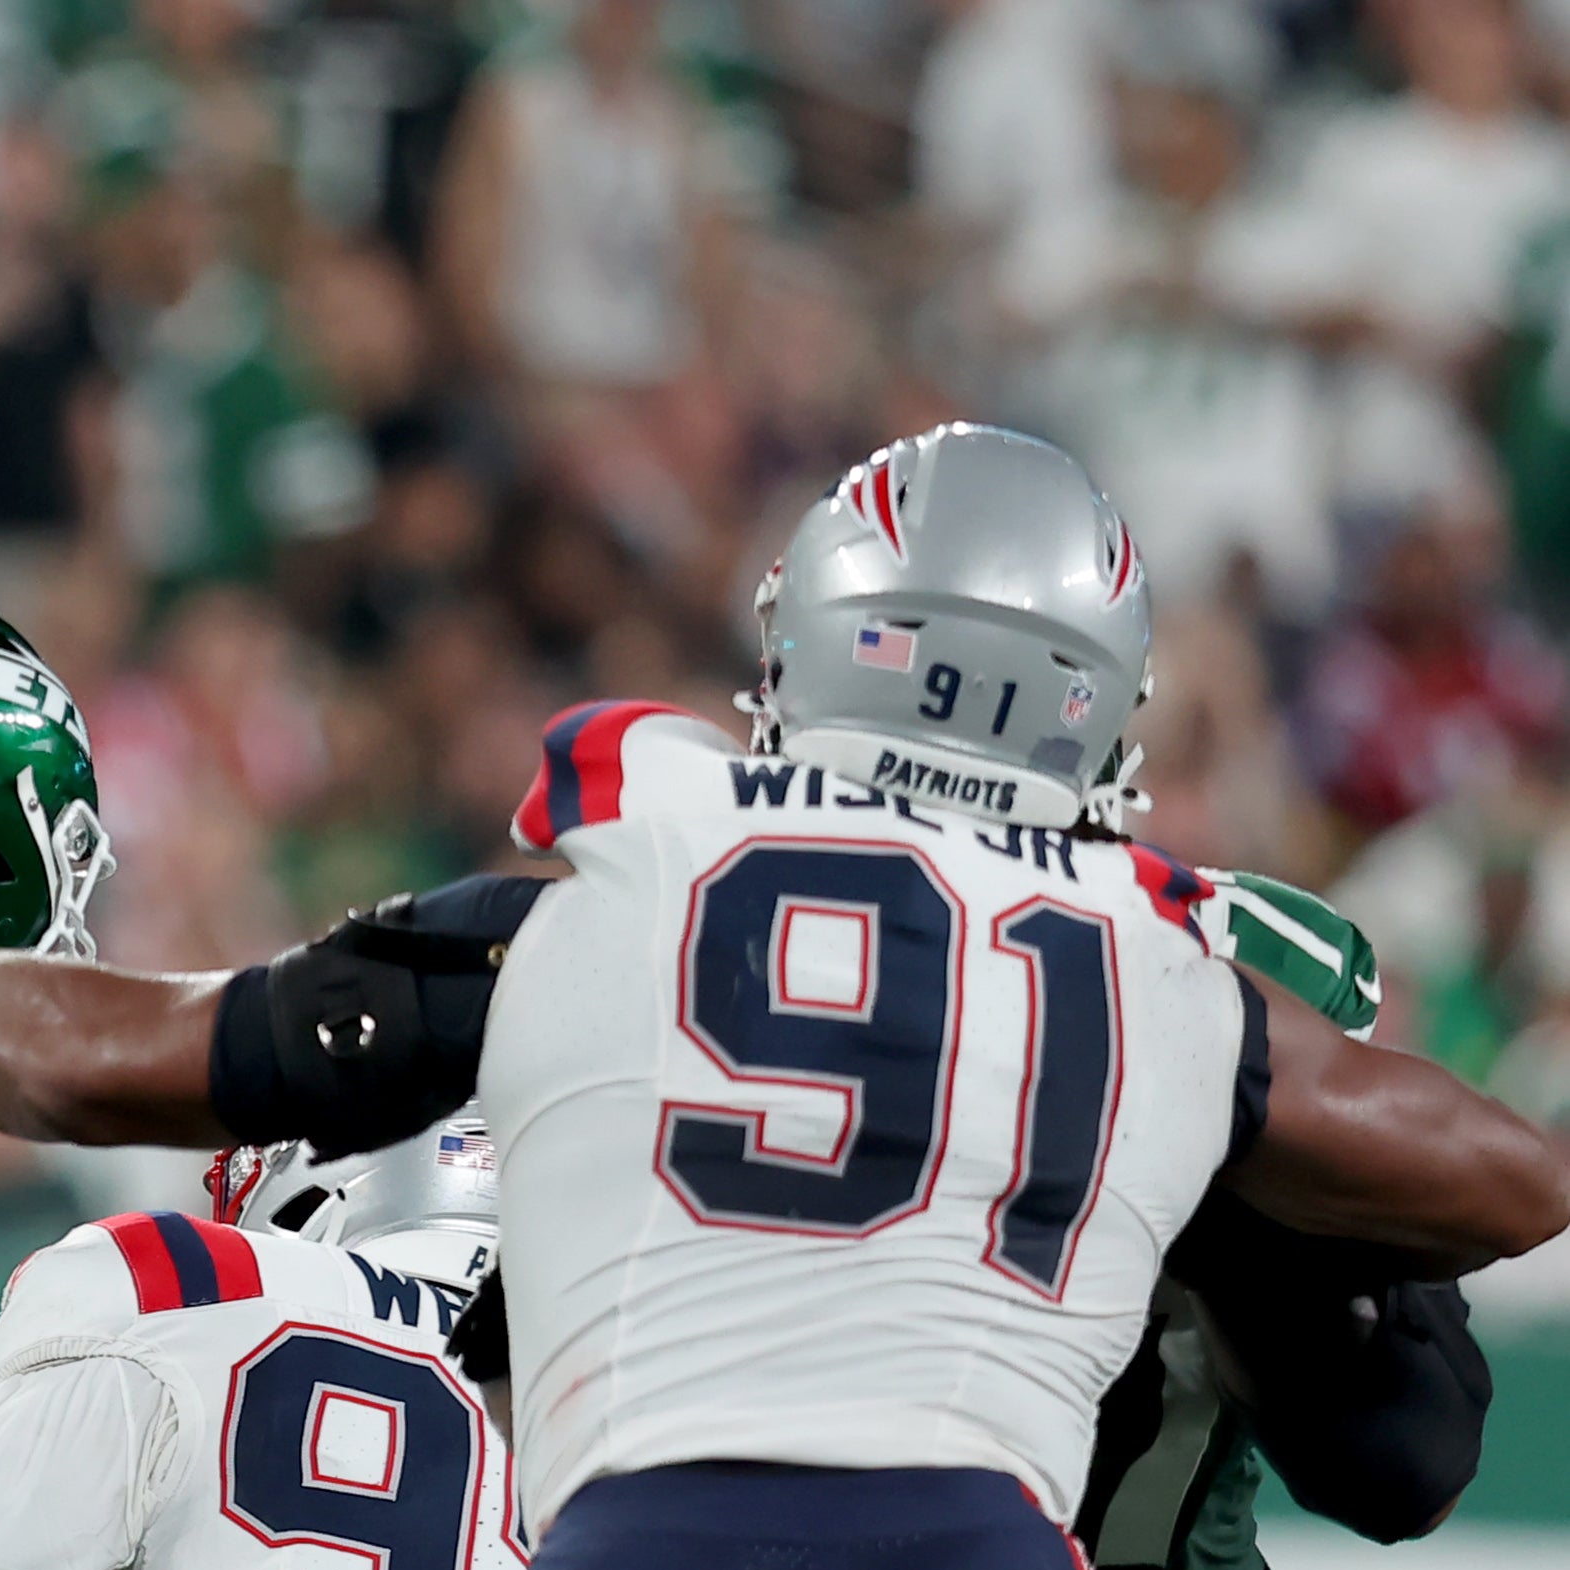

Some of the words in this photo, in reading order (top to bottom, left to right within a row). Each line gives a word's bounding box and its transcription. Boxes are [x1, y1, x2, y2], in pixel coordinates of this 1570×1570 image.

[918, 663, 1017, 736] 91
[874, 750, 1018, 813] PATRIOTS
[654, 835, 1124, 1303] 91
